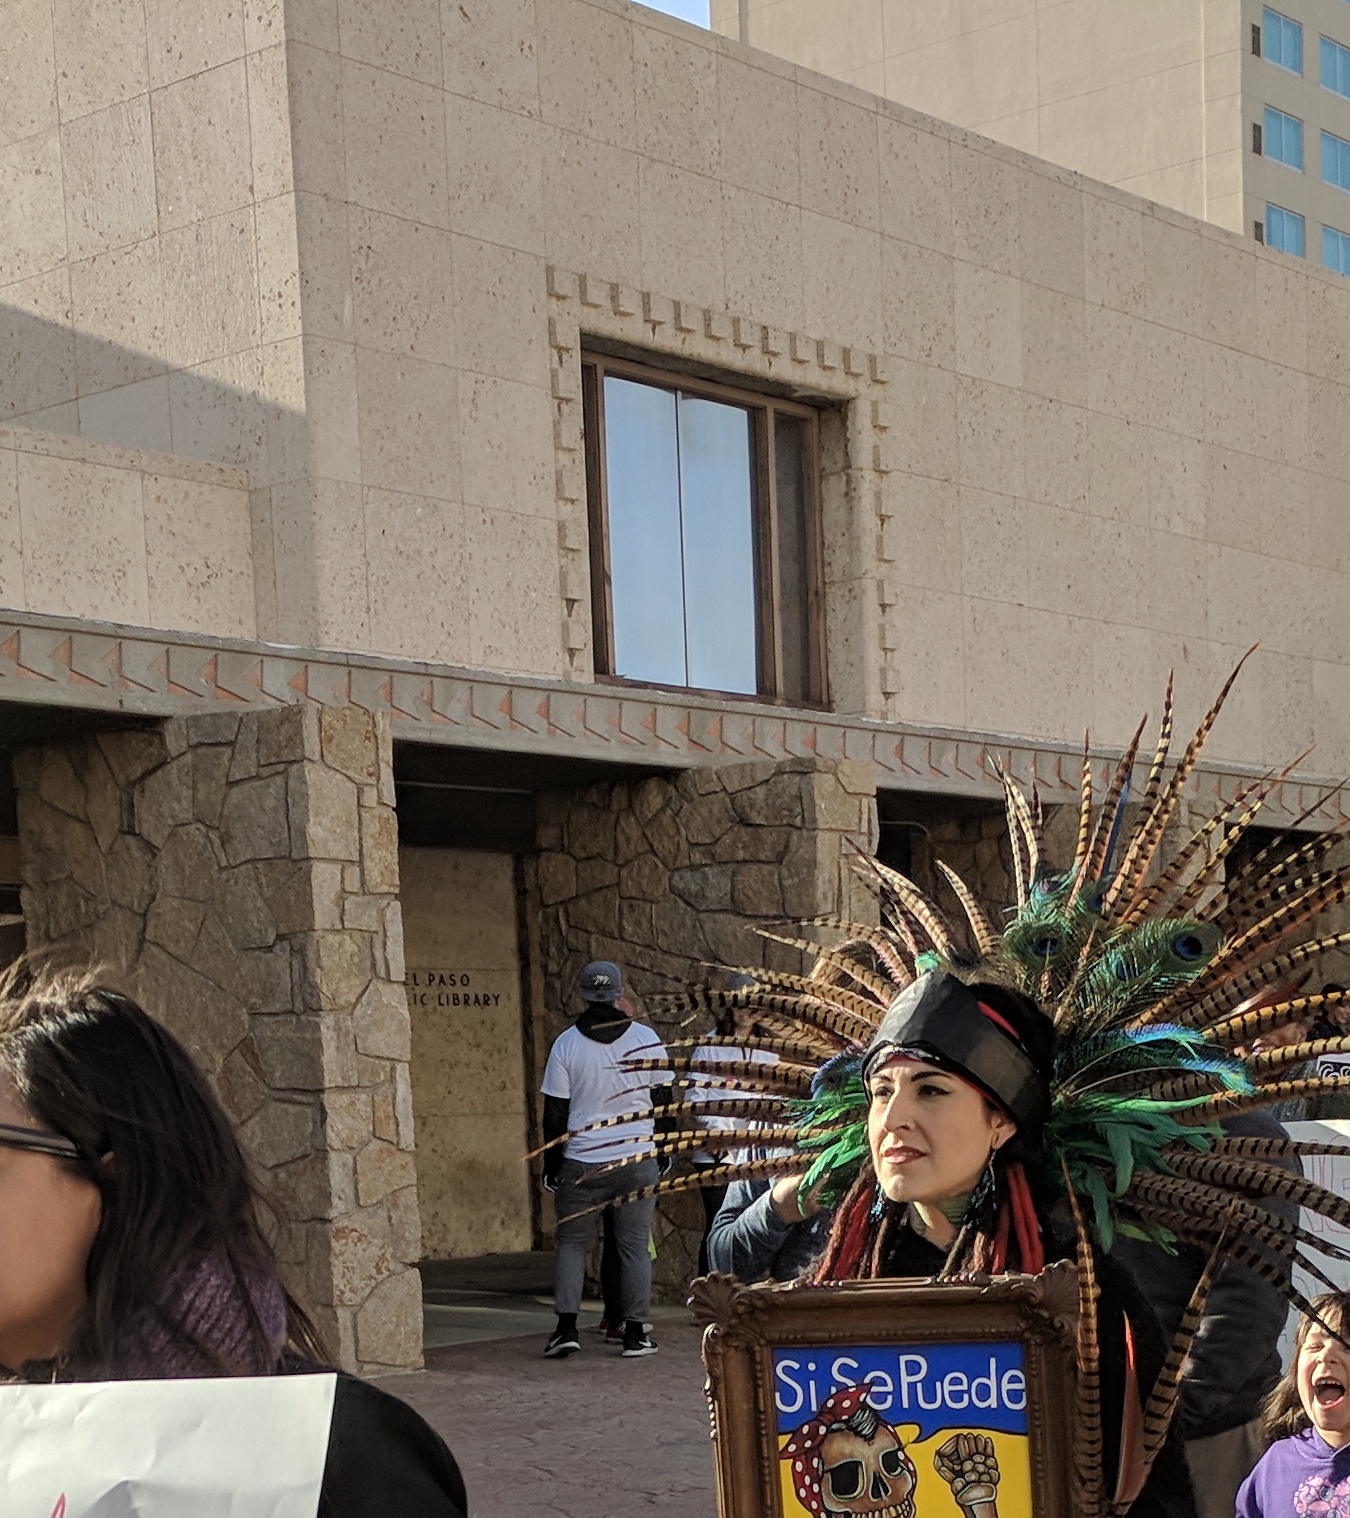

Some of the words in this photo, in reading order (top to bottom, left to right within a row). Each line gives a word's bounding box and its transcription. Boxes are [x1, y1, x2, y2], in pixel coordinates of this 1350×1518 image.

[428, 973, 470, 987] PASO
[438, 993, 500, 1007] LIBRARY
[775, 1359, 818, 1413] Si
[830, 1356, 894, 1412] Se
[899, 1354, 1027, 1411] Puede
